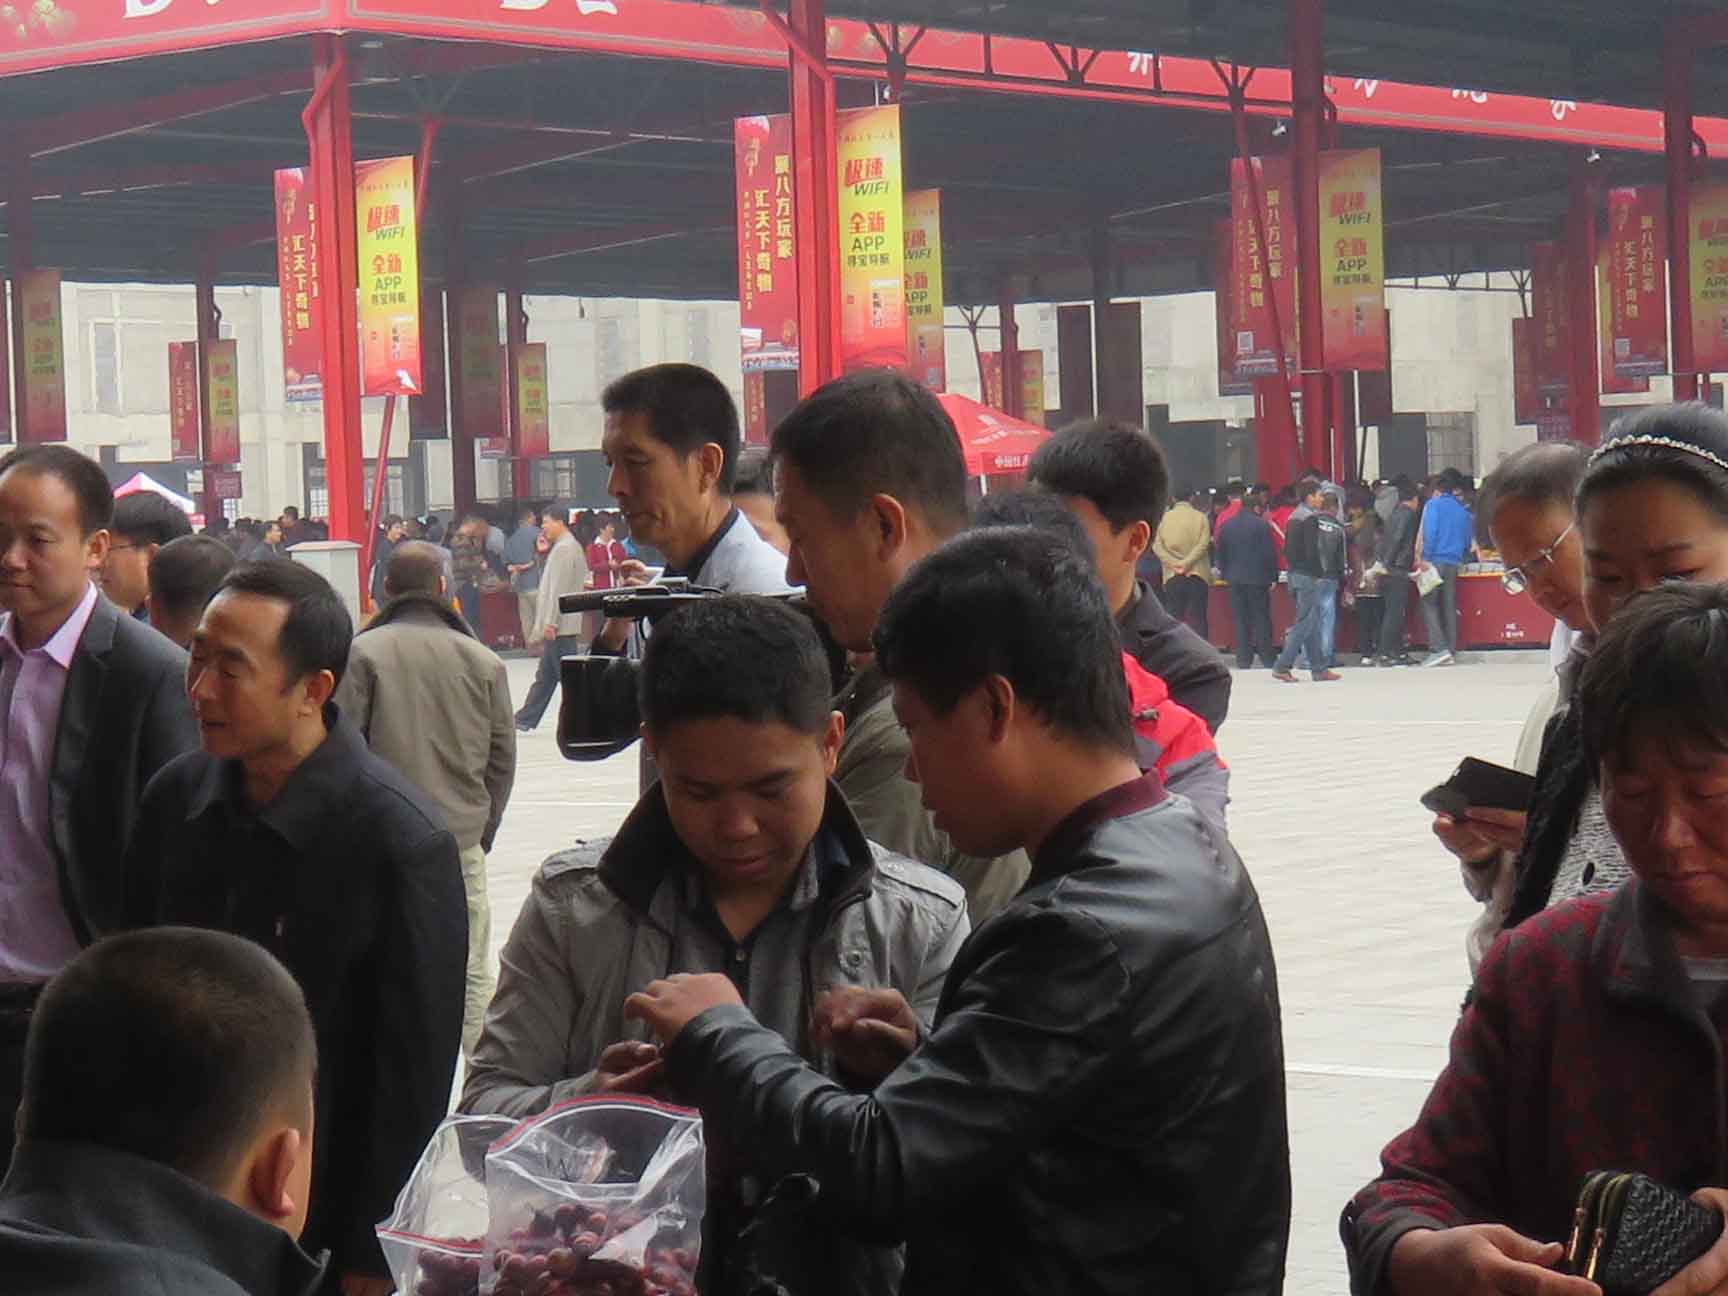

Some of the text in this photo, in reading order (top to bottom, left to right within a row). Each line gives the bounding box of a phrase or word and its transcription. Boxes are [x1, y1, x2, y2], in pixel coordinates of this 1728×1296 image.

[853, 181, 890, 197] WIFI
[851, 235, 885, 251] APP
[1335, 258, 1367, 272] APP
[375, 275, 402, 291] APP
